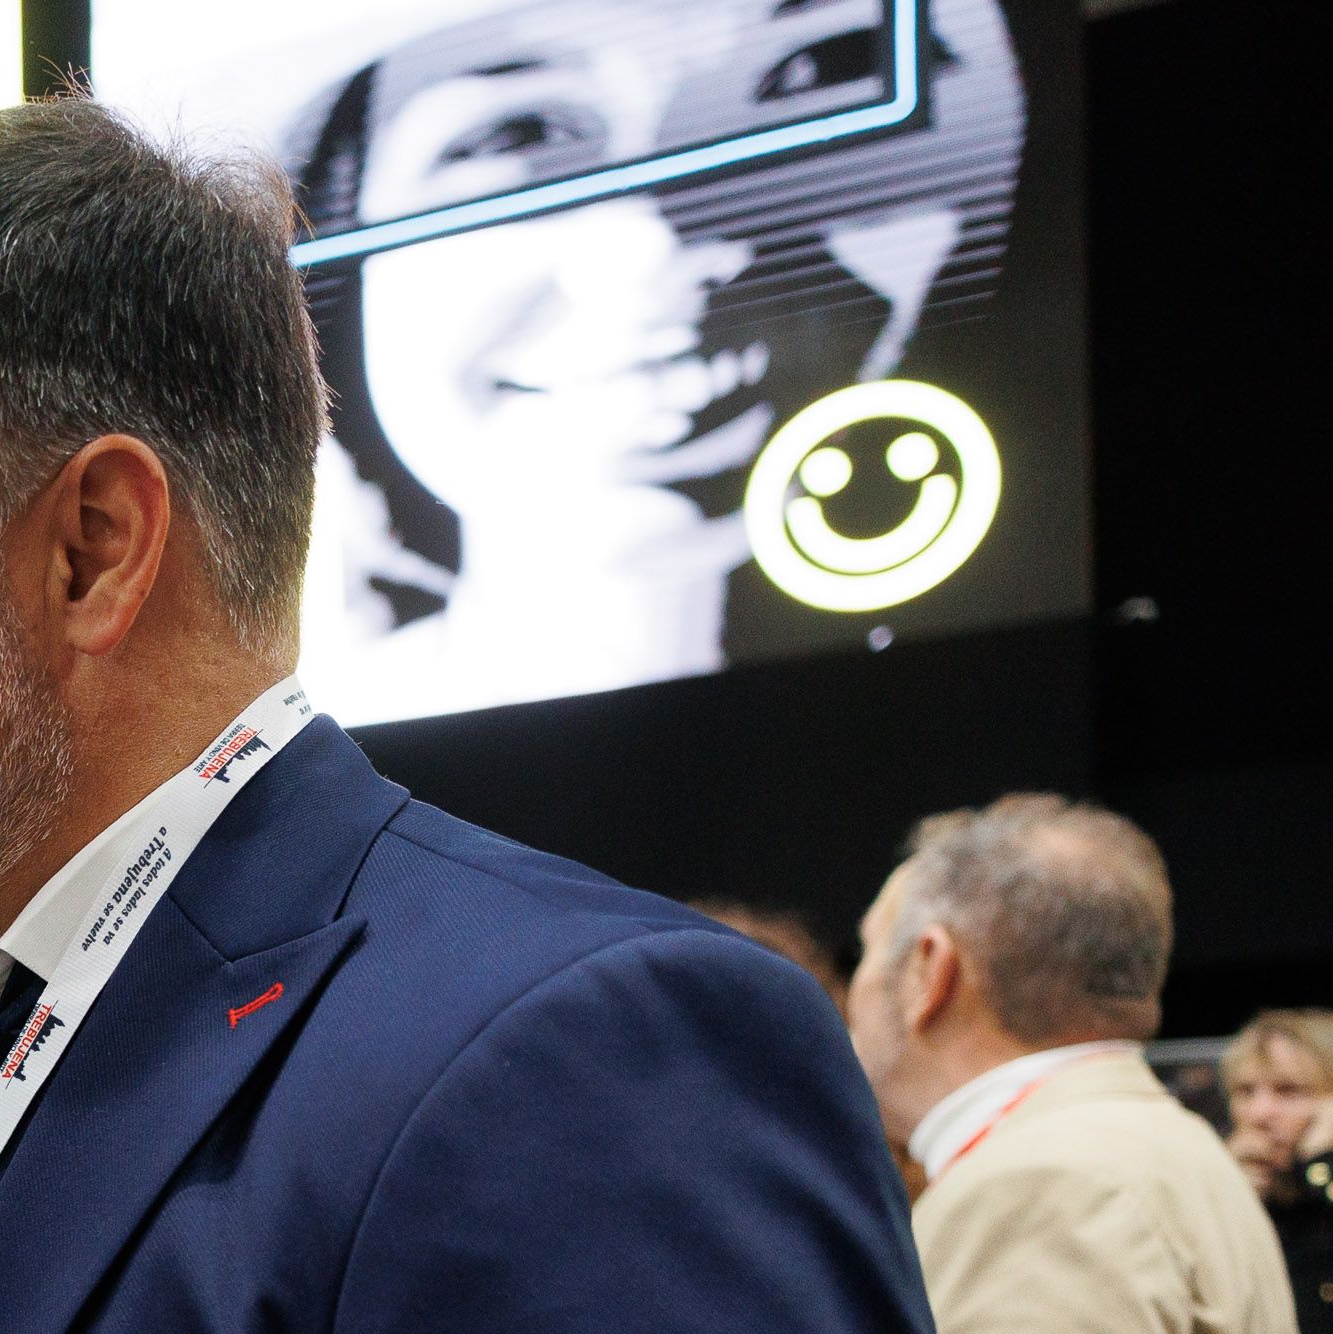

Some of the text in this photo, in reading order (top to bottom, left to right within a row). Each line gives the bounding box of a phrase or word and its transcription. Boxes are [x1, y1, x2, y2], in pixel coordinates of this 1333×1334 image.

[199, 726, 257, 779] TREBUJENA
[82, 826, 167, 951] a Trebujena se vuelve
[103, 848, 172, 945] A todos lados se va
[1, 1004, 52, 1079] TREBUJENA
